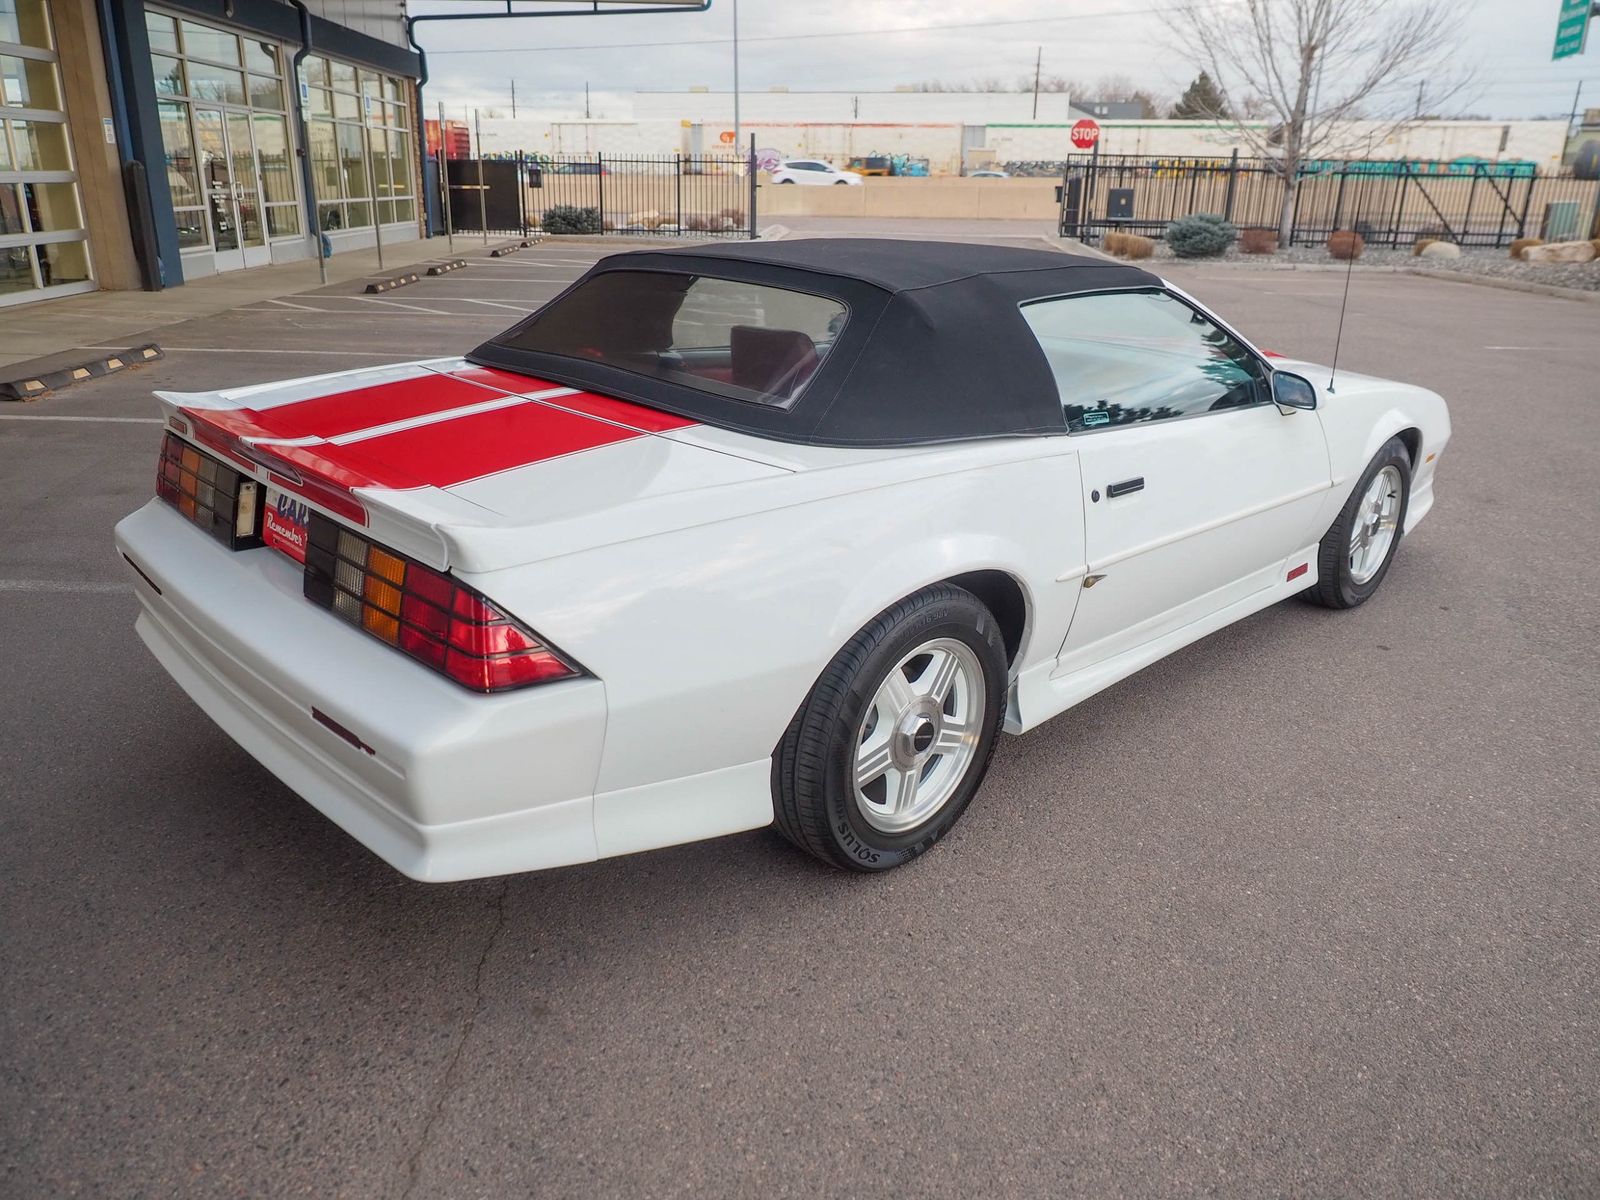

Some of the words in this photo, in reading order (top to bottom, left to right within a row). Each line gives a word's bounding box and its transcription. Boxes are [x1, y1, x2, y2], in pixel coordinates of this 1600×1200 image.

[1072, 128, 1099, 141] STOP
[266, 511, 303, 547] Remember
[838, 822, 880, 863] SOLUS
